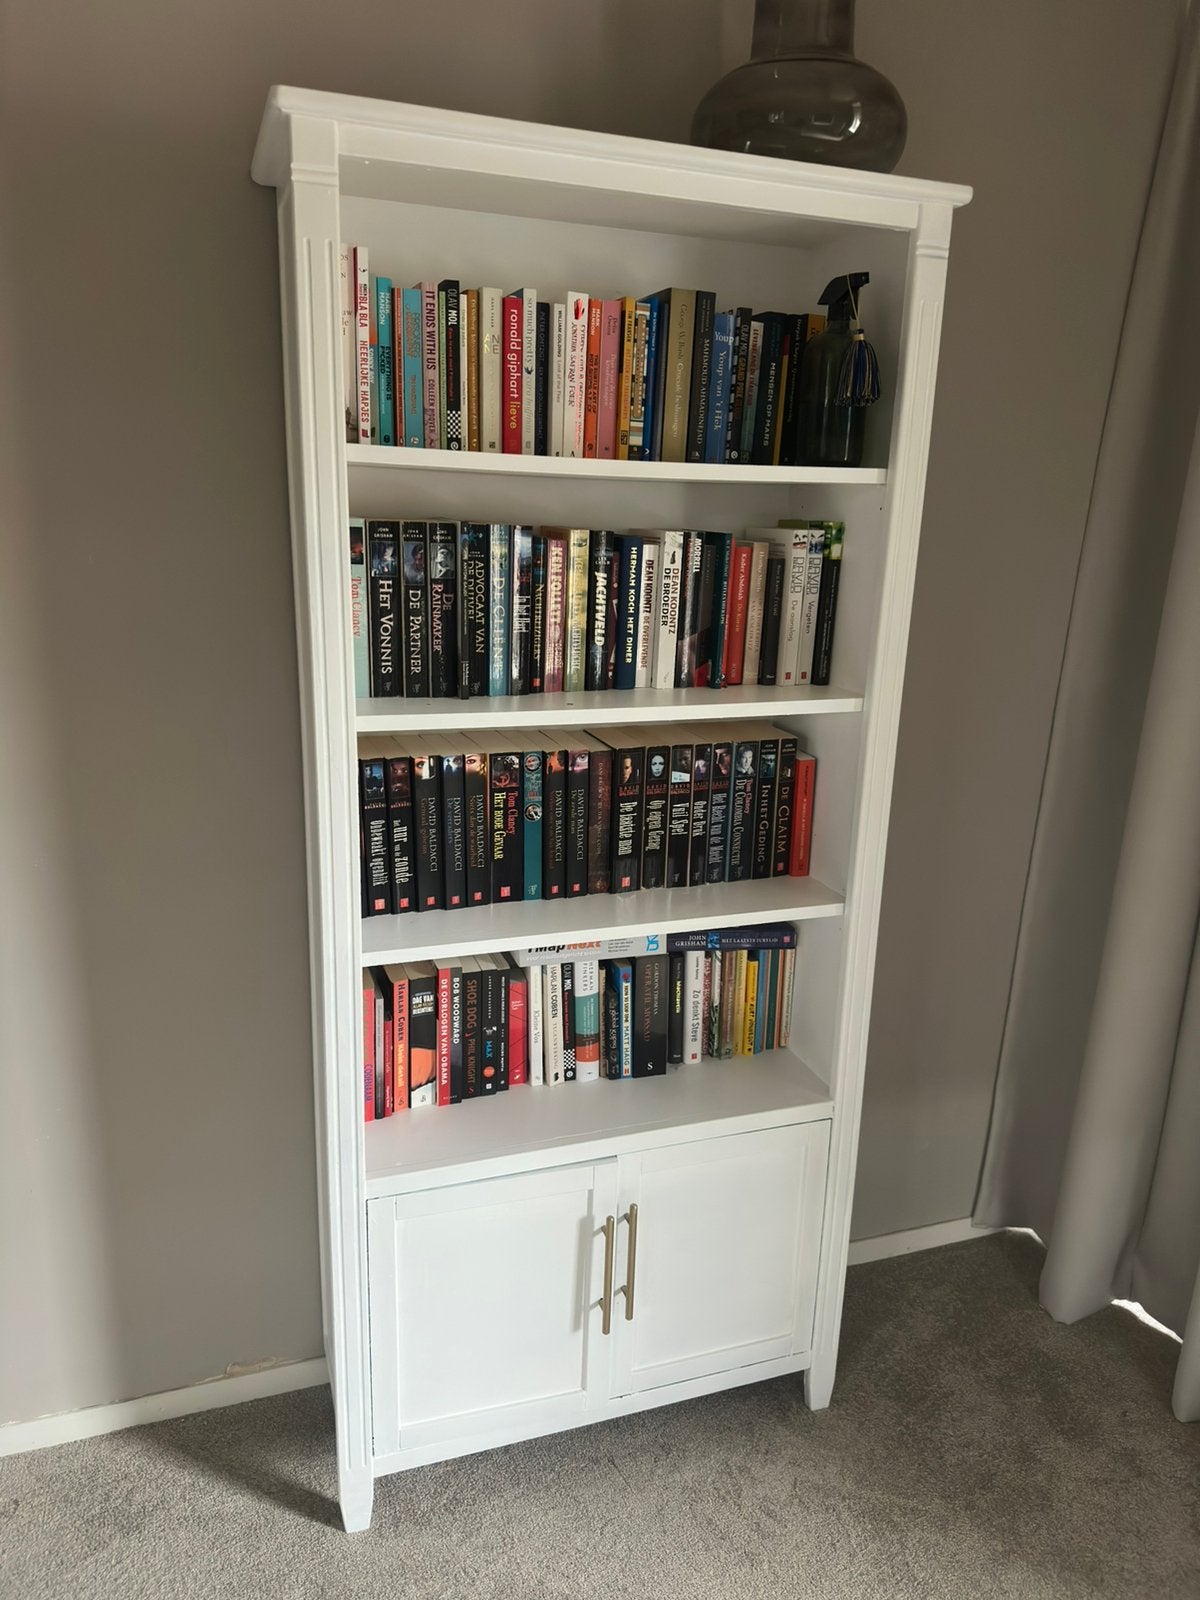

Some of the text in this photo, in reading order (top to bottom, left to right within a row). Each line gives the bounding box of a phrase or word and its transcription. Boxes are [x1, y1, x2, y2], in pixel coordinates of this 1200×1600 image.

[358, 296, 367, 310] BLA
[358, 313, 368, 328] BLA
[448, 288, 458, 326] OLAV MOL
[528, 298, 534, 308] so
[426, 290, 436, 370] IT ENDS WITH US
[715, 332, 734, 344] Youp
[524, 334, 534, 363] pretty
[701, 338, 710, 385] MAHMOUD
[716, 351, 727, 376] Youp
[360, 340, 370, 424] HEERLIJKE HAPJES
[508, 309, 521, 429] ronald giphart lieve
[738, 357, 746, 380] GRAND
[767, 362, 776, 401] MENSEN
[736, 382, 744, 398] PRIX
[696, 388, 707, 444] AHMADINEJAD
[713, 410, 722, 431] Hek
[766, 404, 772, 417] OP
[763, 419, 772, 446] MARS
[693, 539, 702, 572] MORRELL
[550, 546, 562, 624] KEN FOLLETT
[794, 557, 805, 593] DAVID
[810, 557, 821, 595] DAVID
[352, 576, 362, 637] Tom Clancy
[476, 561, 484, 653] ADVOCAAT VAN
[595, 571, 607, 646] JACHTVELD
[628, 589, 636, 613] KOCH
[641, 560, 654, 668] DEAN KOONTZ DE OVERLEVENDE
[661, 568, 671, 626] DE BROEDER
[668, 568, 679, 635] DEAN KOONTZ
[737, 603, 743, 611] De
[379, 580, 394, 674] HET VONNIS
[409, 590, 422, 675] DE PARTNER
[432, 584, 454, 653] DE RAINMAKER
[788, 600, 799, 641] De aanslag
[805, 600, 815, 634] Vergeten
[476, 794, 484, 822] DAVID
[712, 793, 727, 804] Het
[744, 793, 752, 815] Clancy
[762, 784, 771, 797] IN
[494, 792, 506, 859] HET RODE GEVAAR
[506, 791, 518, 834] Tom Clancy
[618, 802, 637, 855] De laatste man
[646, 800, 666, 851] Op eigen Gezag
[670, 802, 689, 835] Vuil Spel
[693, 801, 707, 837] Onder Druk
[711, 806, 726, 823] Recht
[711, 824, 724, 835] van
[731, 779, 747, 865] DE COLOMBIA CONNECTIE
[777, 787, 790, 853] DE CLAIM
[370, 820, 386, 856] Onbewaakt
[428, 797, 437, 872] DAVID BALDACCI
[453, 797, 462, 871] DAVID BALDACCI
[758, 820, 769, 862] GEDING
[370, 858, 388, 887] ogenblik
[709, 845, 723, 864] Macht
[467, 980, 477, 1005] SHOE
[564, 979, 572, 991] MOL
[467, 1007, 477, 1028] DOG
[610, 1010, 618, 1028] global
